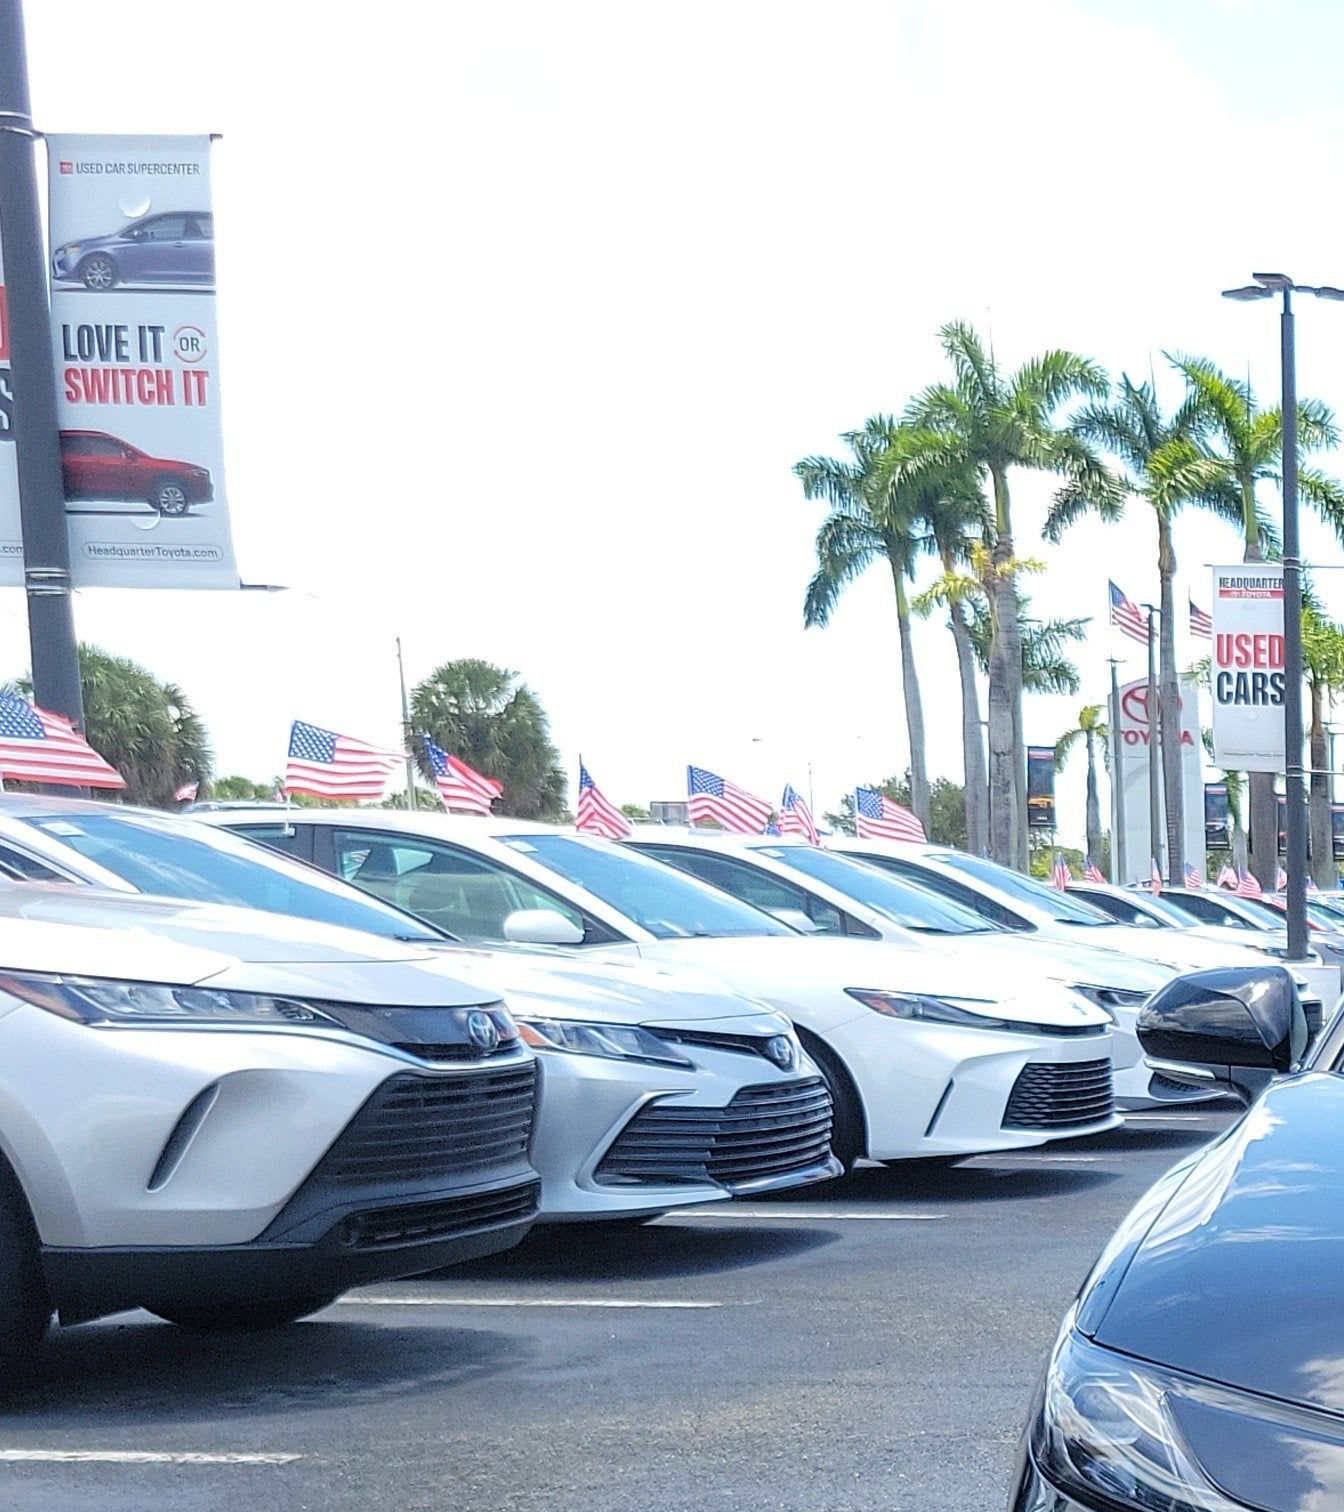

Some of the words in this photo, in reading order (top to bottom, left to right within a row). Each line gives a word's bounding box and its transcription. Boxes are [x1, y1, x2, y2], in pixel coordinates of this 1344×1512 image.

[76, 163, 103, 174] USED
[105, 163, 126, 174] CAR
[127, 163, 200, 175] SUPERCENTER
[62, 324, 131, 362] LOVE
[138, 325, 165, 363] IT
[179, 336, 200, 352] OR
[64, 367, 175, 406] SWITCH
[183, 369, 209, 406] IT
[88, 545, 218, 559] HeadquarterToyota.com
[1216, 634, 1285, 669] USED
[1216, 671, 1286, 706] CARS
